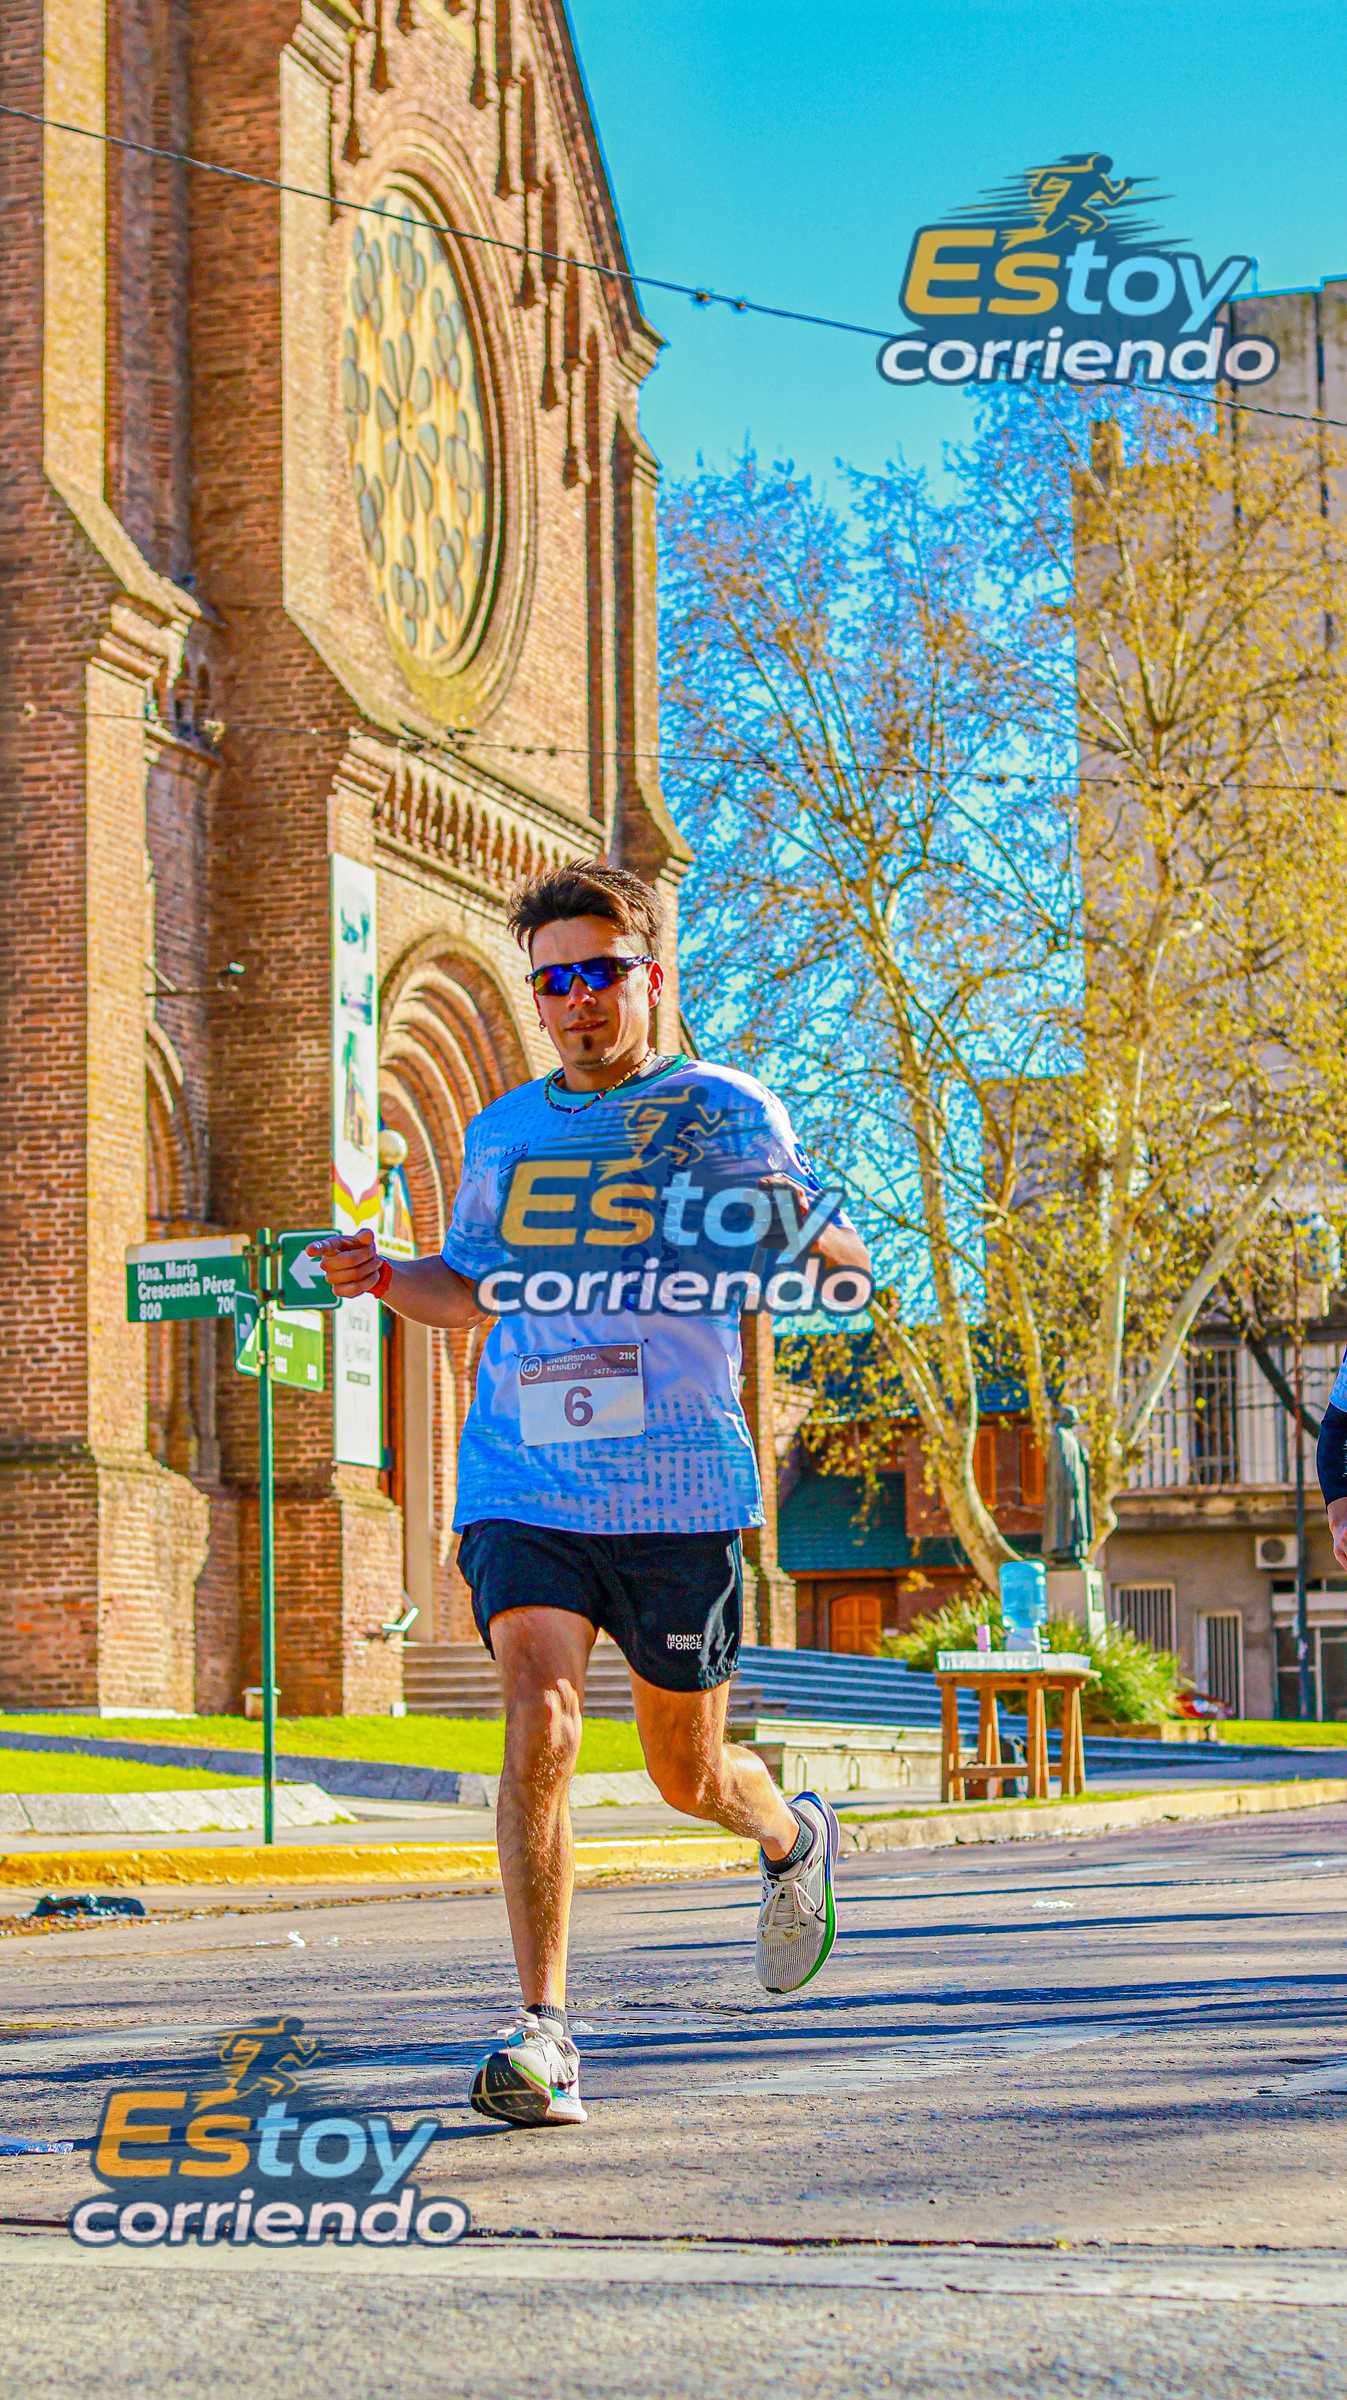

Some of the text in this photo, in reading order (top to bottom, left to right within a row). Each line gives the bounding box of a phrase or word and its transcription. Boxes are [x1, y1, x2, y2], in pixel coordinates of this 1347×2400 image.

[137, 1263, 164, 1281] Hna.
[138, 1278, 201, 1302] Crescencia
[139, 1302, 162, 1320] 800
[618, 1352, 636, 1361] 21K
[563, 1385, 594, 1428] 6
[666, 1633, 703, 1642] MONKY
